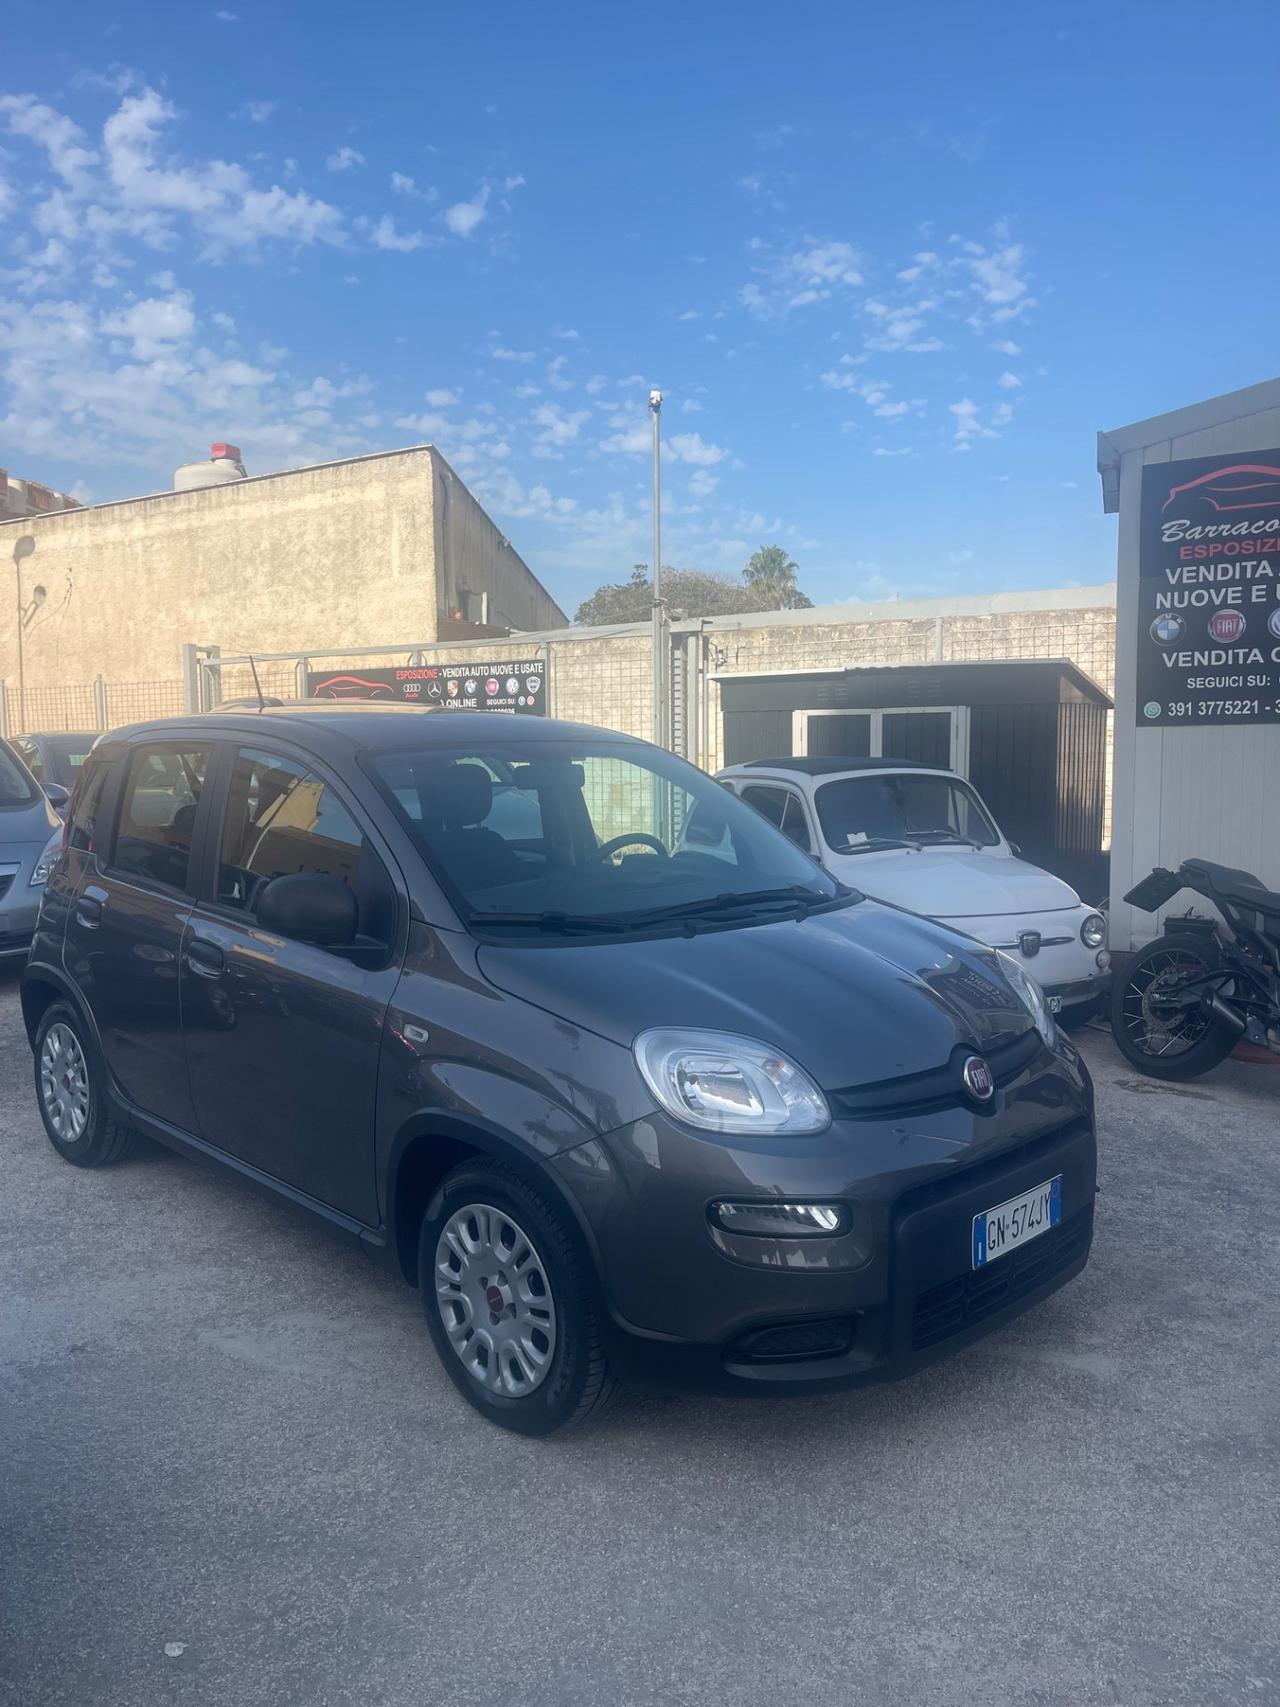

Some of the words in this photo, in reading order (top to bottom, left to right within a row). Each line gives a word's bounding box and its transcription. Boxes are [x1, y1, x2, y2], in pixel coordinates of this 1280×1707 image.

[1165, 560, 1273, 585] VENDITA
[1156, 587, 1242, 609] NUOVE
[1252, 585, 1267, 602] E
[1217, 618, 1239, 633] FIAT
[1162, 648, 1264, 667] VENDITA
[396, 669, 438, 680] ESPOSIZIONE
[442, 667, 470, 678] VENDITA
[469, 665, 489, 676] AUTO
[490, 664, 513, 675] NUOVE
[514, 664, 520, 674] E
[520, 663, 543, 673] USATE
[1187, 676, 1242, 688] SEGUICI
[1247, 675, 1270, 686] SU:
[446, 698, 477, 708] ONLINE
[1168, 702, 1192, 716] 391
[1198, 700, 1258, 715] 3775221
